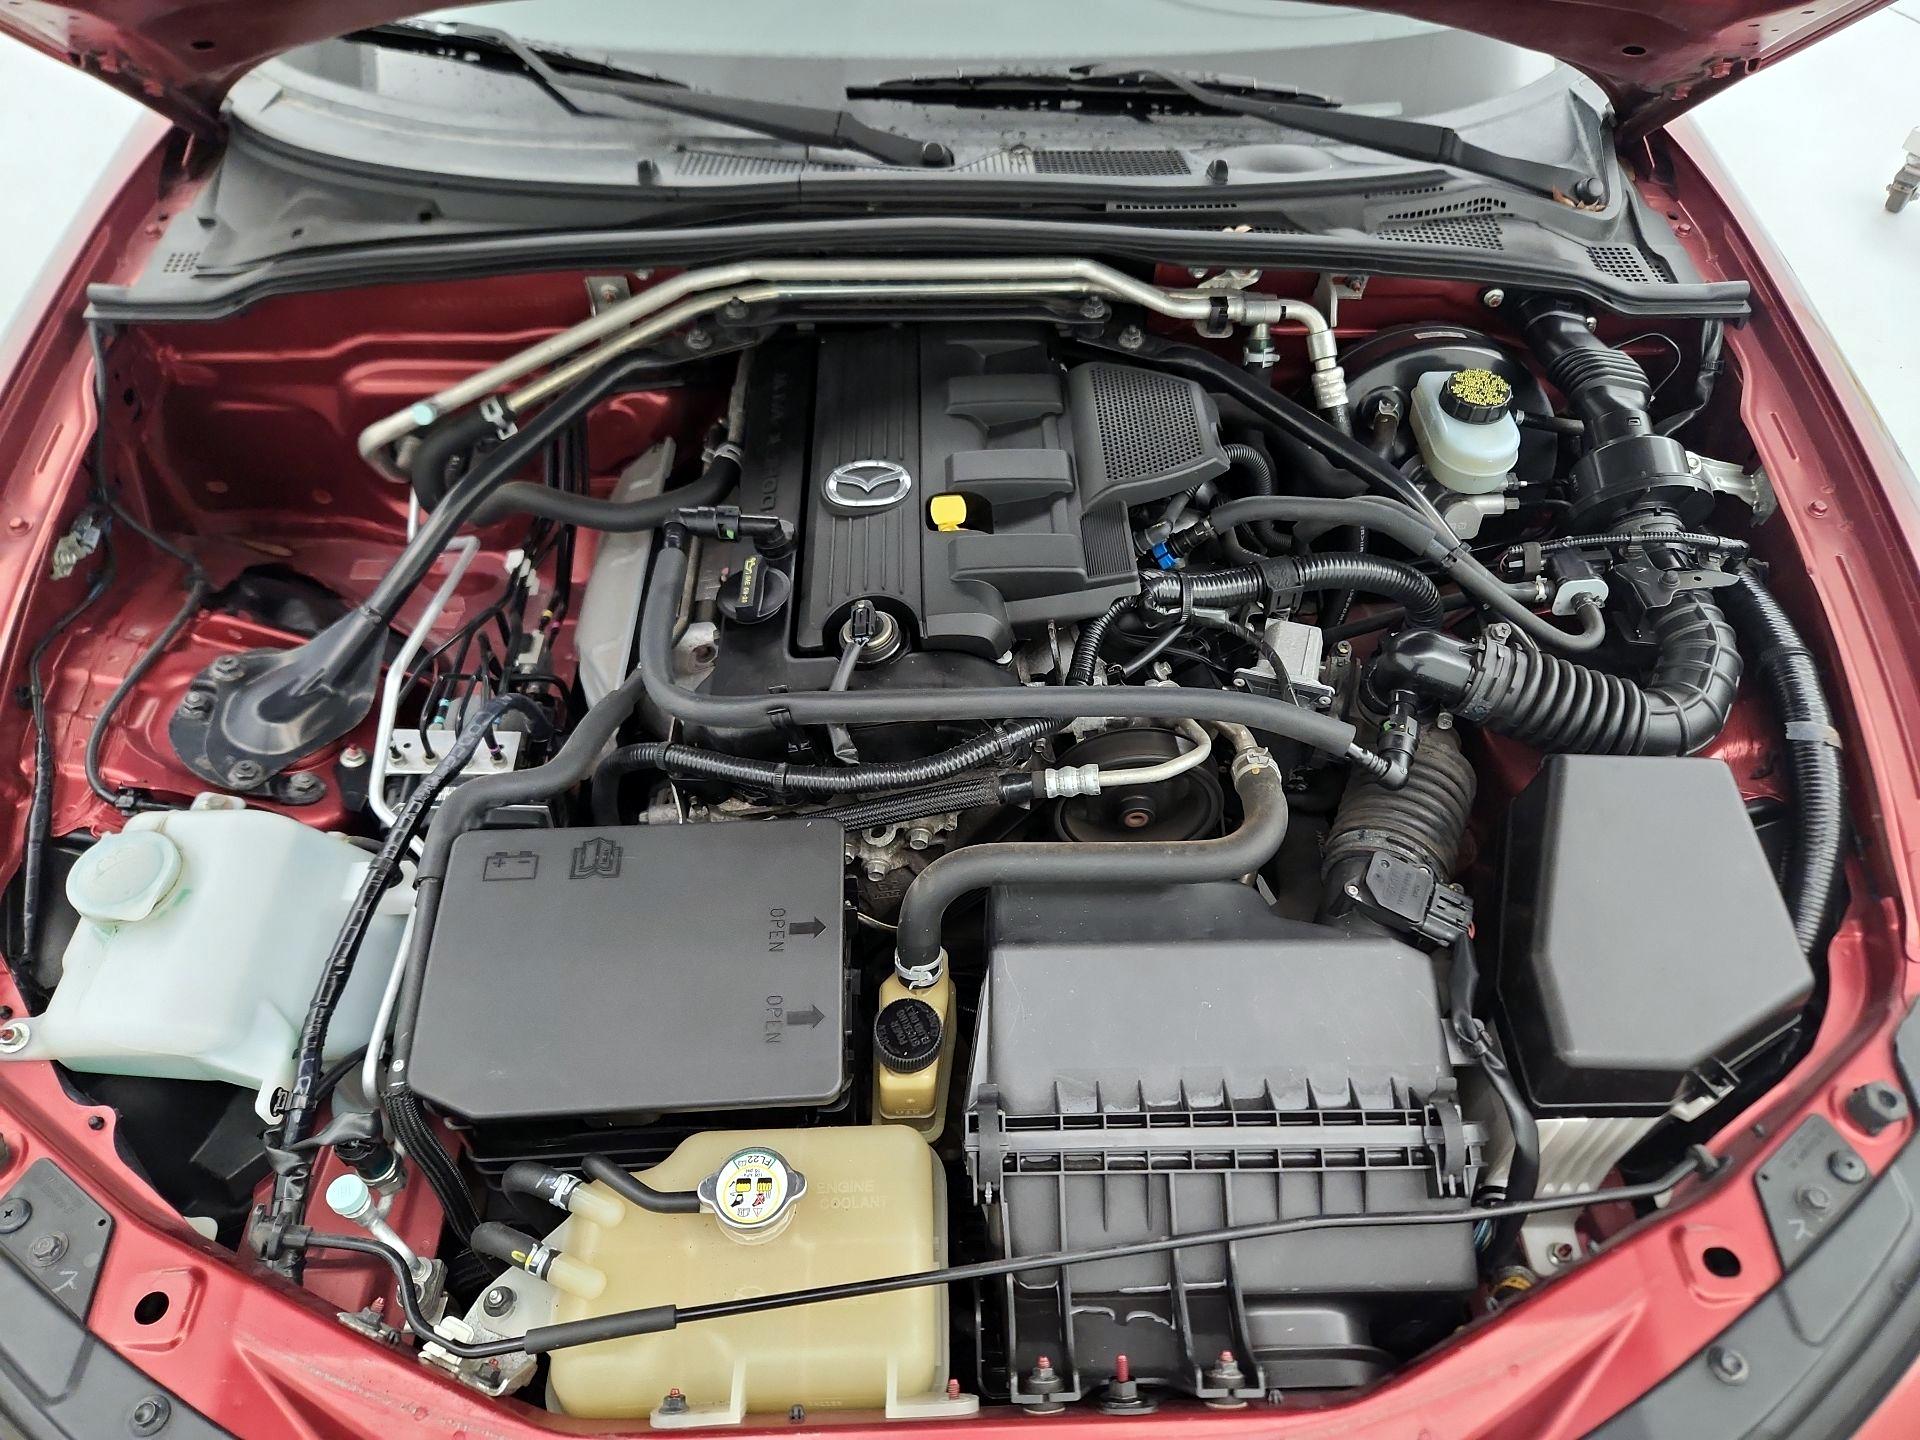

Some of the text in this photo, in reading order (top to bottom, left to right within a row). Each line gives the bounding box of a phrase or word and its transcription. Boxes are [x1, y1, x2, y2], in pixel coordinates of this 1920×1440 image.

[769, 908, 786, 952] OPEN
[766, 995, 783, 1043] OPEN
[896, 1009, 921, 1047] STEERING
[747, 1155, 772, 1167] FL22
[817, 1179, 876, 1193] ENGINE
[820, 1195, 888, 1210] COOLANT
